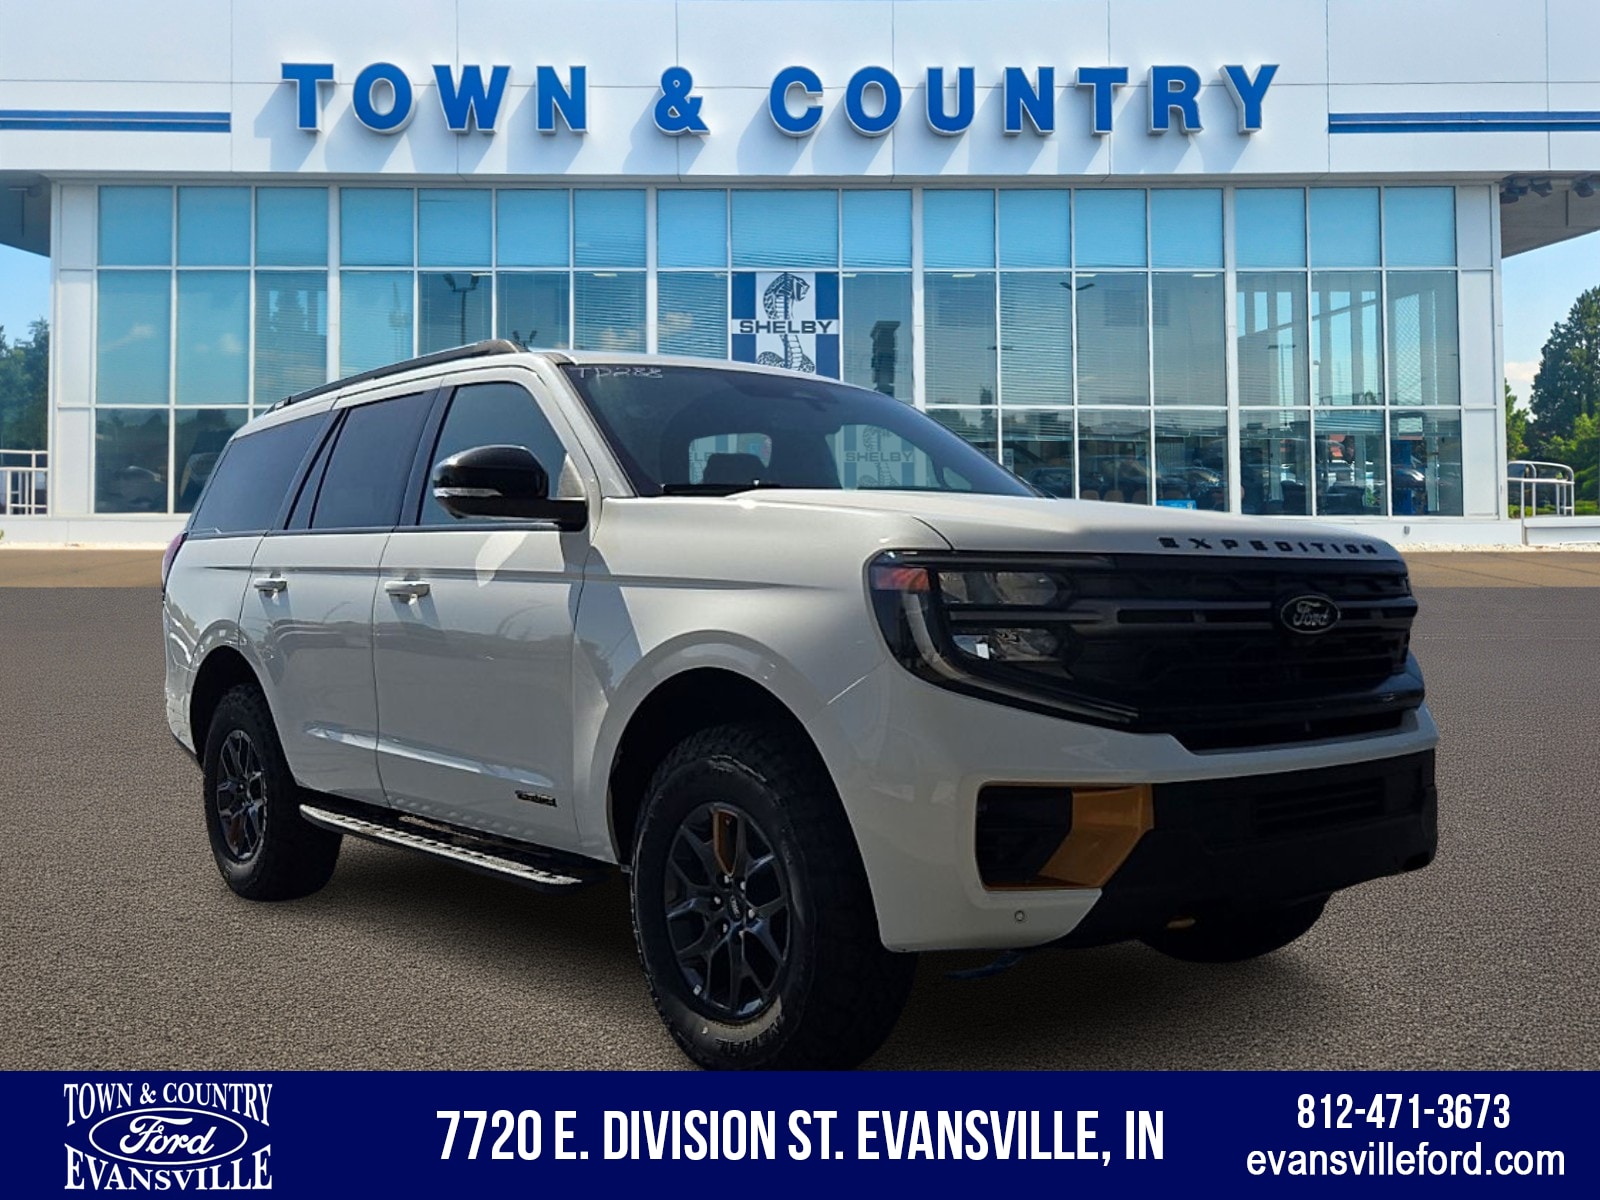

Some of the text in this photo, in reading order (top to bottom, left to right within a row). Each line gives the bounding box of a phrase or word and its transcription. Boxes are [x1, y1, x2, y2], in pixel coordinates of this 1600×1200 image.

[282, 63, 1280, 137] TOWN & COUNTRY
[739, 320, 833, 334] SHELBY
[845, 451, 914, 463] SHELBY
[1157, 536, 1379, 555] EXPEDITION
[1292, 600, 1330, 627] Ford
